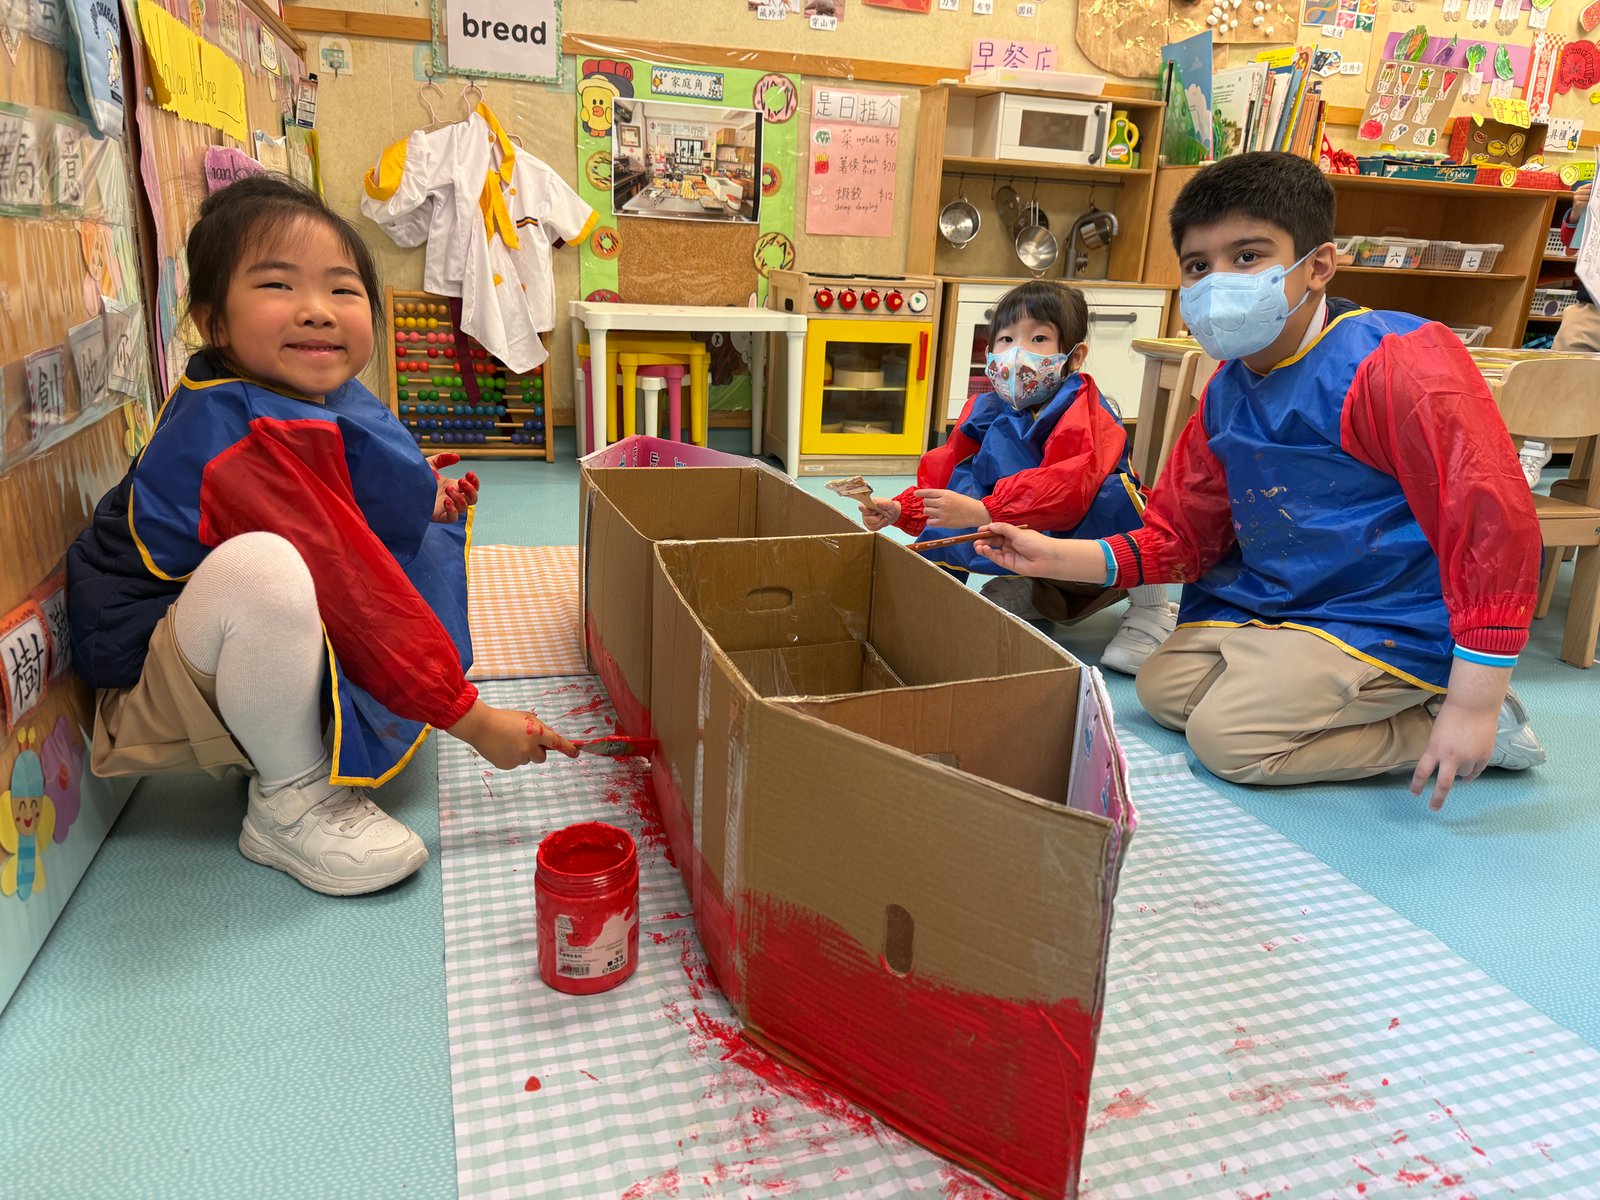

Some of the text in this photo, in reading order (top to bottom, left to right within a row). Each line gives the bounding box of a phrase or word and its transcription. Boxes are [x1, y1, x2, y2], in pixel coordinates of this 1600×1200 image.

[462, 12, 546, 45] bread
[811, 18, 836, 28] 穿山甲
[1342, 64, 1361, 72] 信用卡
[671, 76, 703, 91] 家庭角
[816, 92, 897, 125] 是日推介
[841, 129, 853, 149] 菜
[885, 133, 896, 147] $6
[1547, 129, 1567, 141] 具櫃
[883, 159, 896, 174] $20
[879, 187, 894, 203] $12
[1390, 252, 1402, 264] 六
[1466, 257, 1477, 267] 七
[9, 633, 45, 710] 樹
